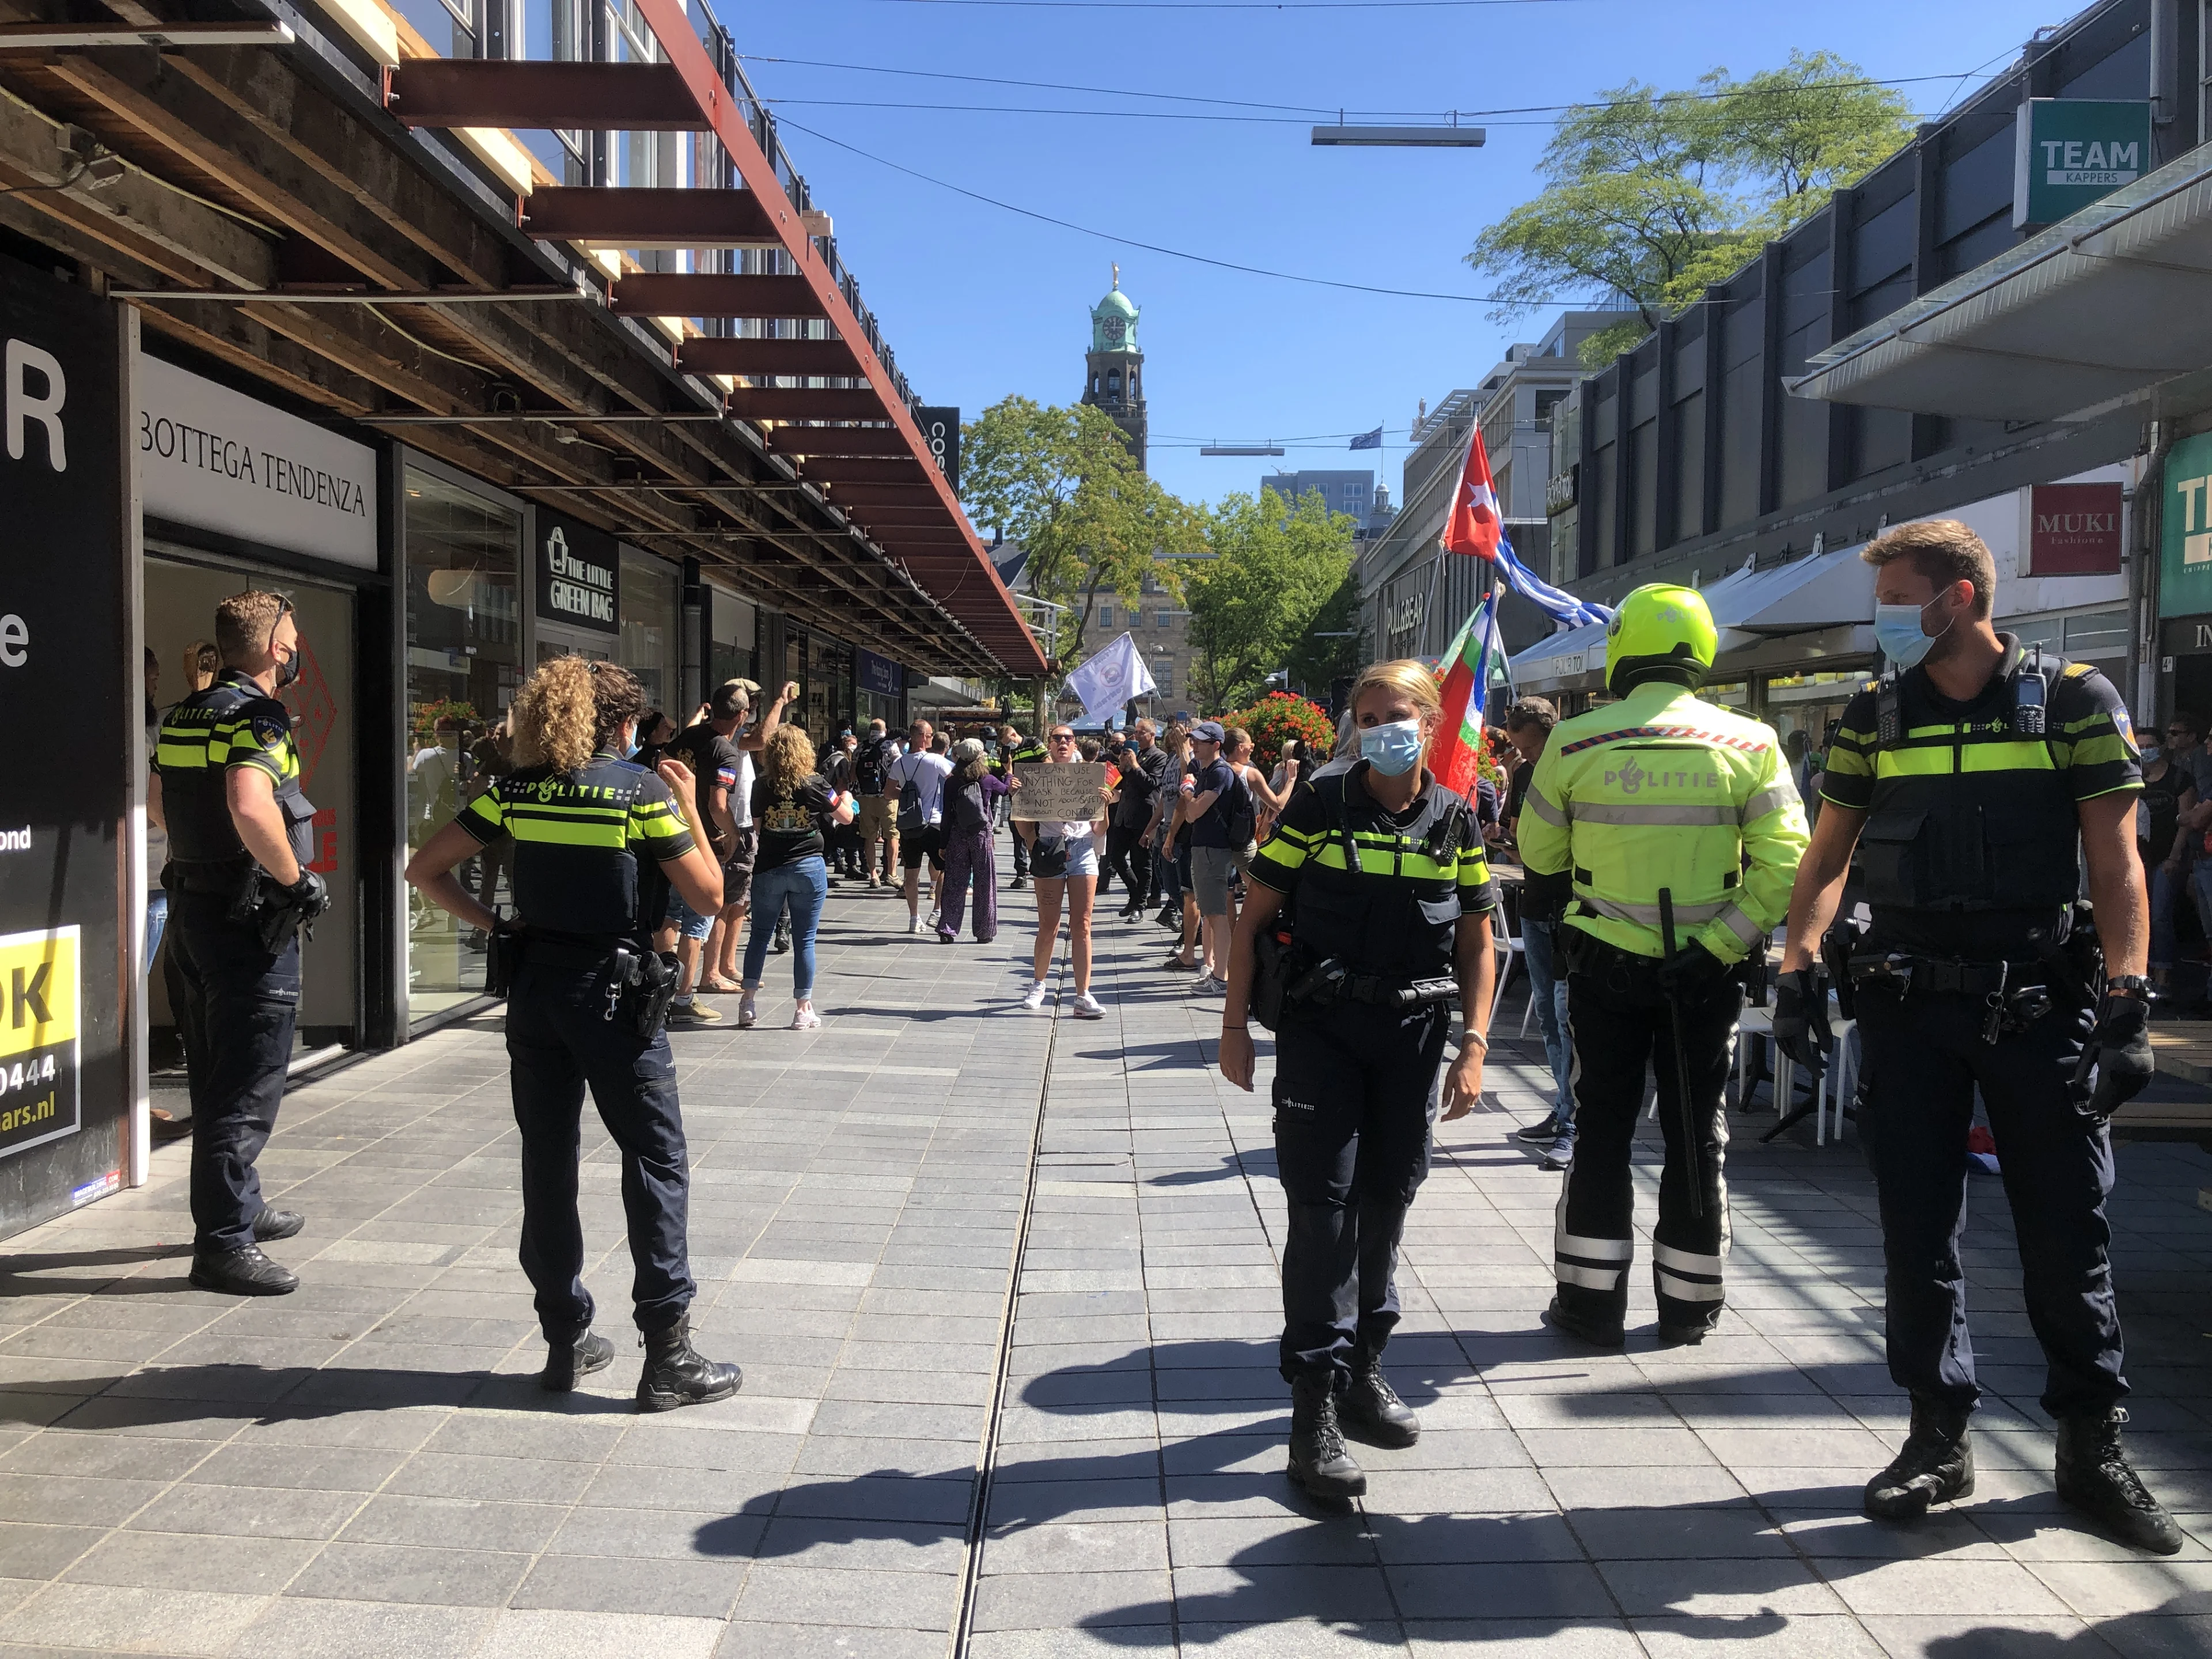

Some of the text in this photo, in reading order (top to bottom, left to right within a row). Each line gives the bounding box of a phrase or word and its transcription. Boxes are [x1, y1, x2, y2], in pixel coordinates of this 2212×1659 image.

[2040, 141, 2138, 169] TEAM
[2066, 172, 2118, 183] KAPPERS
[141, 410, 366, 517] BOTTEGA TENDENZA
[2037, 513, 2116, 533] MUKI
[567, 556, 613, 590] THE LITTLE
[550, 579, 614, 623] GREEN BAG
[1388, 592, 1423, 637] PULL&BEAR
[1556, 654, 1583, 676] POUR TOI
[1019, 766, 1091, 776] YOU CAN USE
[1077, 778, 1095, 787] FOR
[1604, 756, 1718, 794] POLITIE
[527, 774, 616, 802] POLITIE
[1061, 787, 1093, 796] BECAUSE
[1035, 798, 1055, 808] NOT
[1079, 795, 1103, 805] SAFETY
[1057, 806, 1099, 819] CONTROL
[2, 1091, 55, 1131] ars.nl
